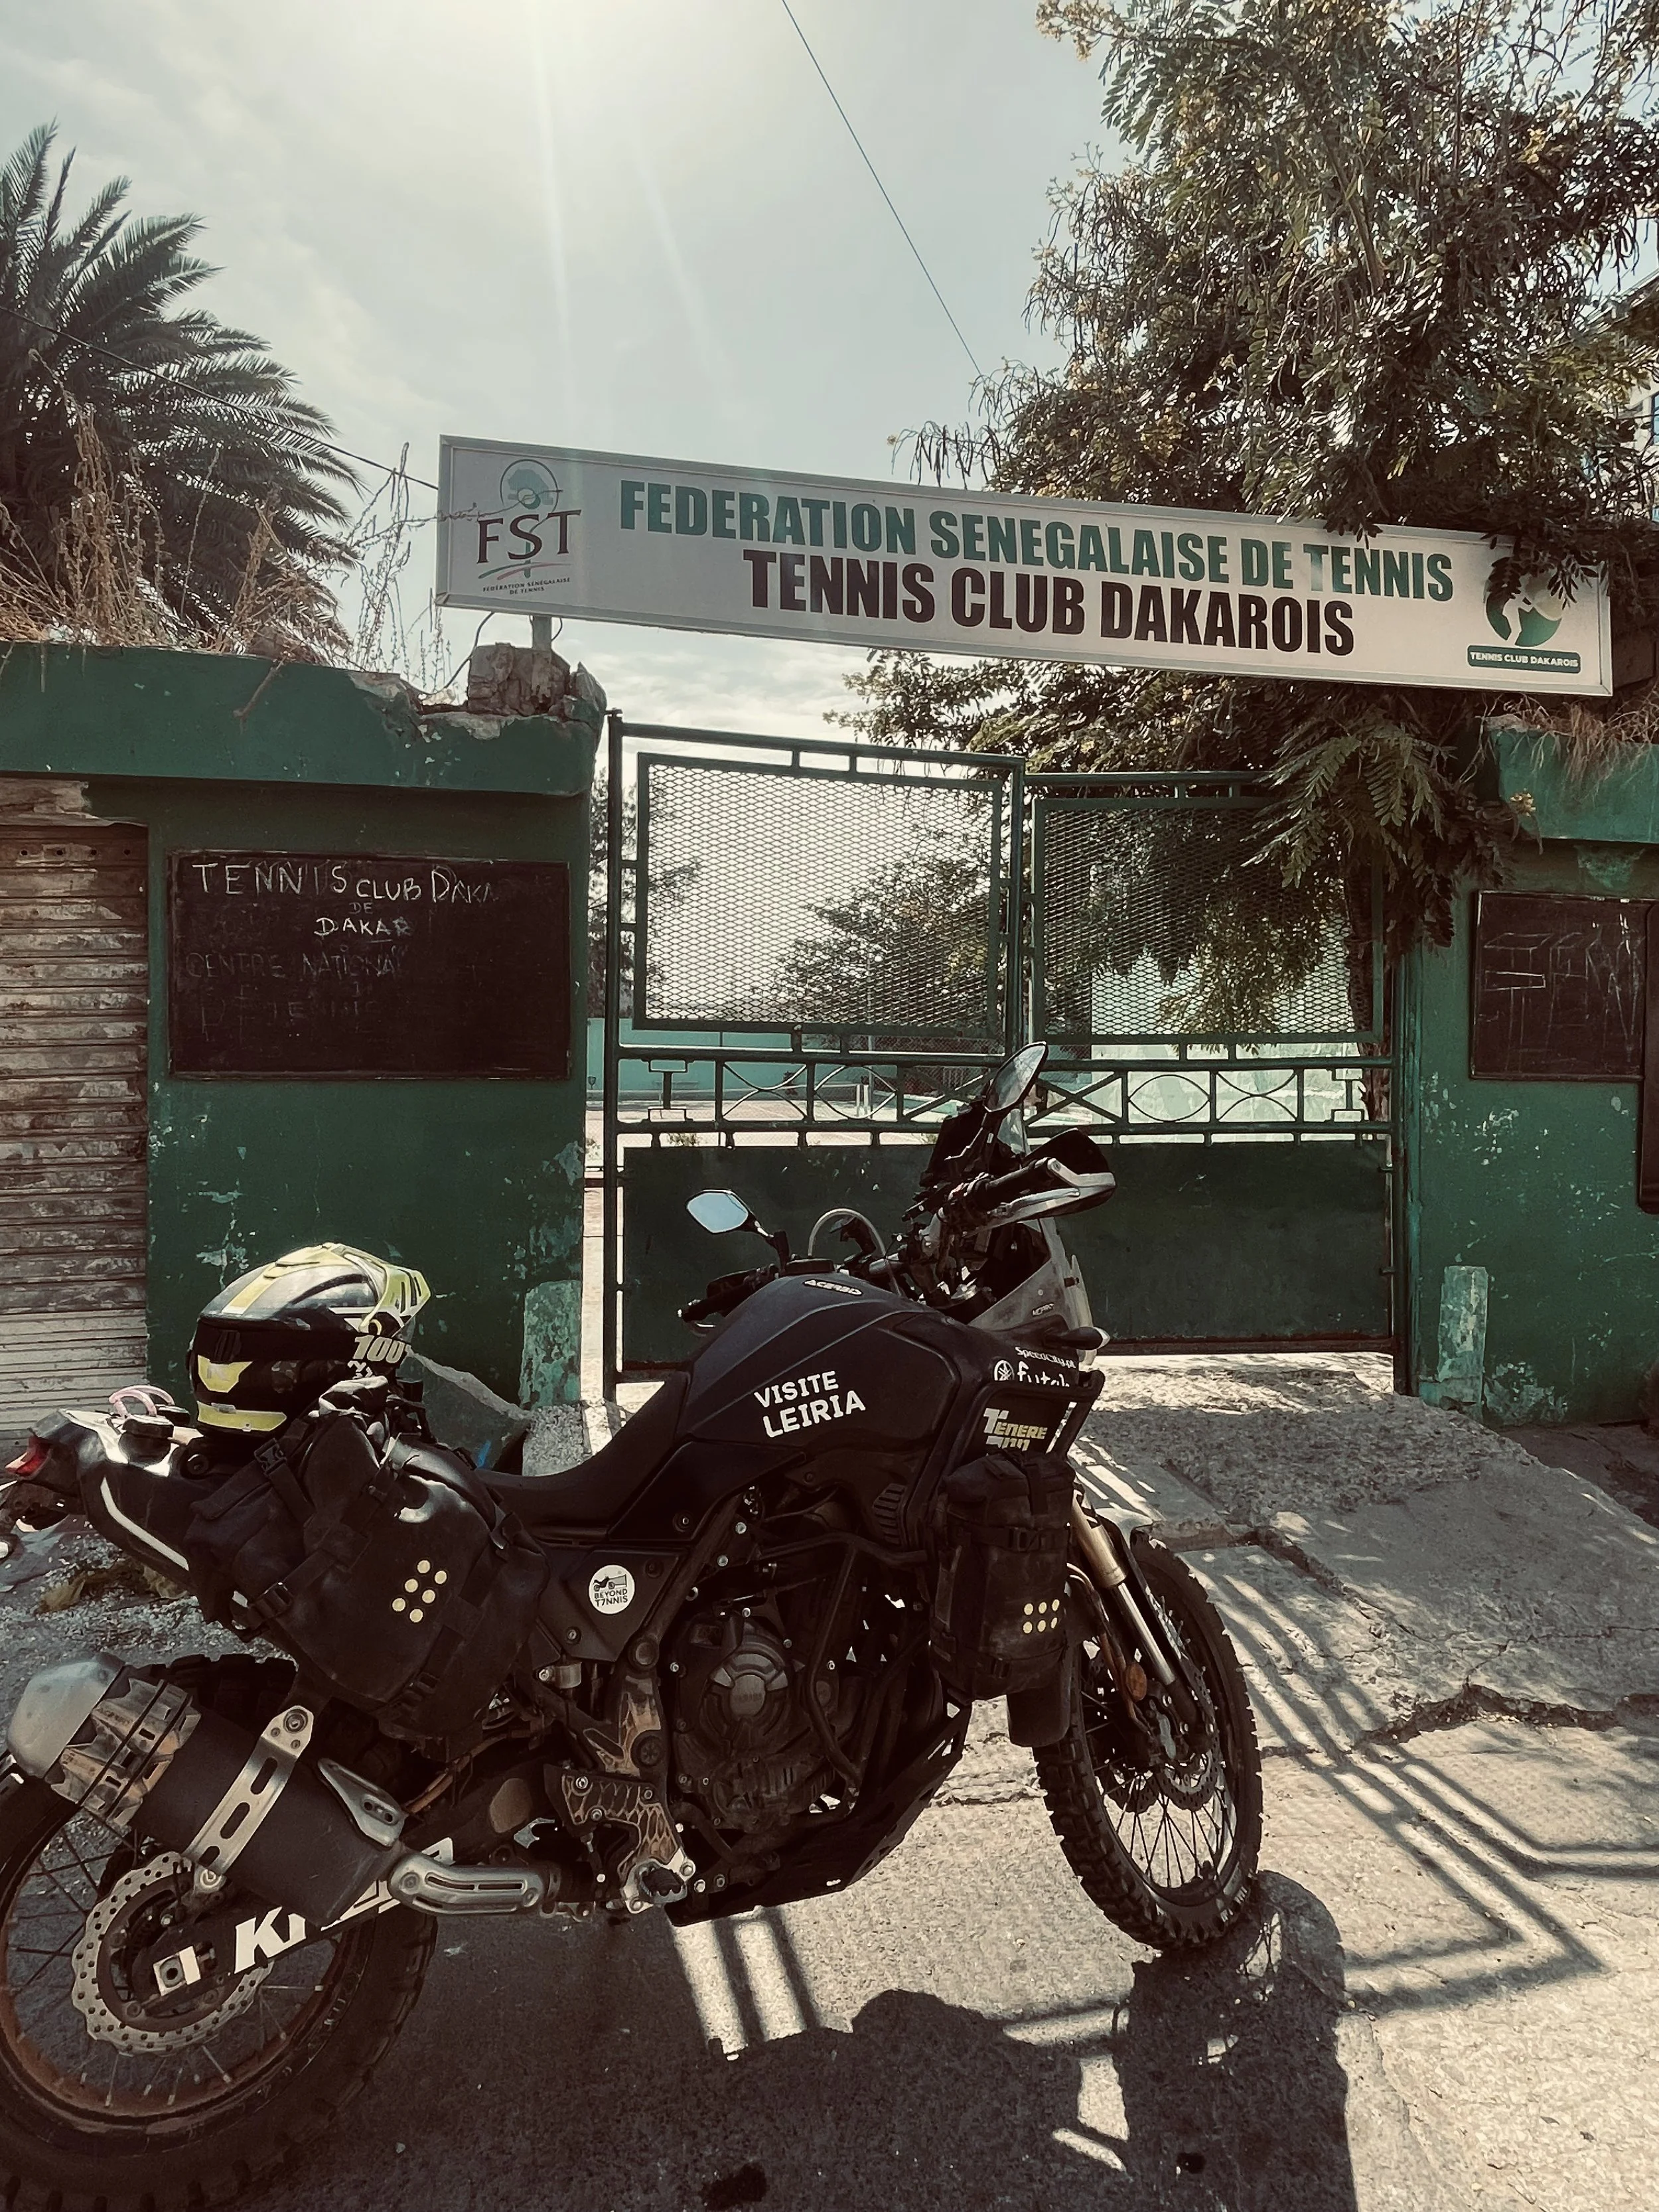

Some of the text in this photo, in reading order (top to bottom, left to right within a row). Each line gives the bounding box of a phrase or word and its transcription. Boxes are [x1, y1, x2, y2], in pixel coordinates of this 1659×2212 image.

[476, 509, 582, 564] FST
[620, 479, 1453, 601] FEDERATION SENEGALAISE DE TENNIS
[743, 549, 1354, 656] TENNIS CLUB DAKAROIS
[1470, 652, 1579, 667] TENNIS CLUB DAKAROIS
[192, 864, 346, 895] TENNIS
[356, 878, 422, 901] CLUB
[754, 1370, 839, 1408] VISITE
[762, 1390, 866, 1438] LEIRIA
[594, 1589, 628, 1599] BEYOND
[595, 1595, 628, 1607] T7NNIS
